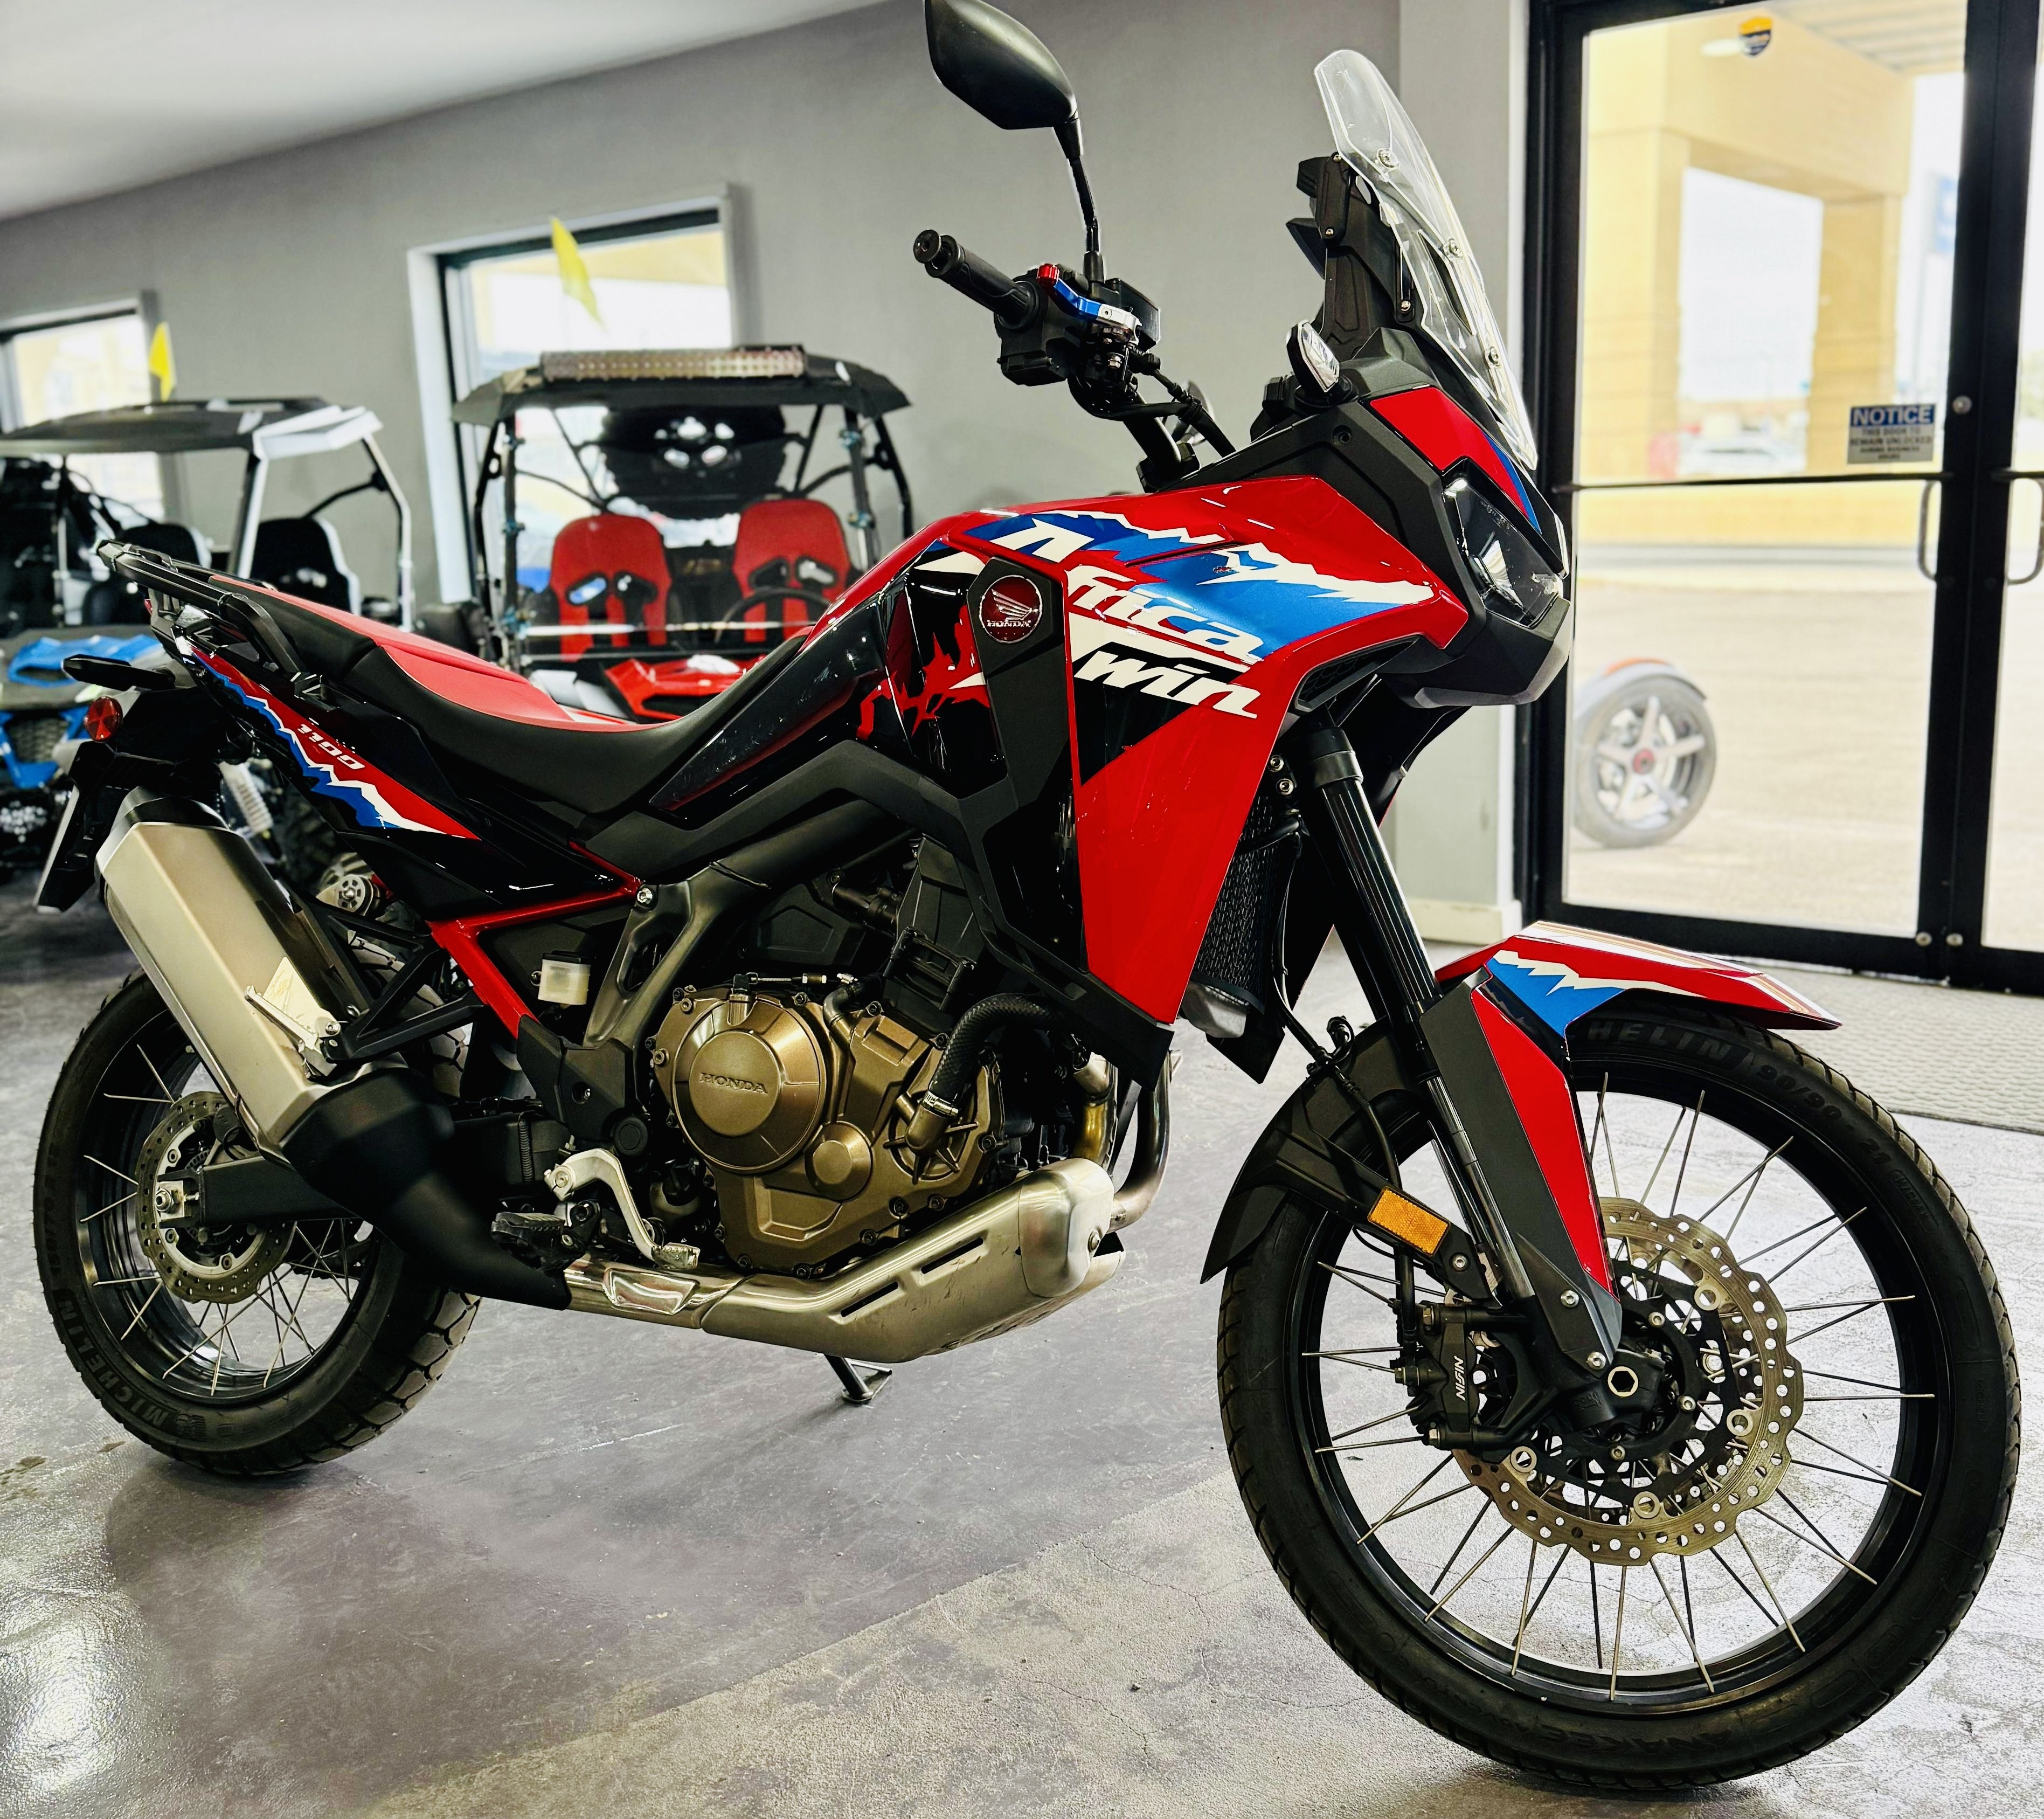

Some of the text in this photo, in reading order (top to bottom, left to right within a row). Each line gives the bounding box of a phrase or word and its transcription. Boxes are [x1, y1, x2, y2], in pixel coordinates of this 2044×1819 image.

[297, 184, 365, 231] 1100
[1853, 405, 1931, 425] NOTICE
[987, 619, 1031, 627] HONDA
[699, 1073, 768, 1095] HONDA
[57, 1299, 169, 1428] MICHELIN
